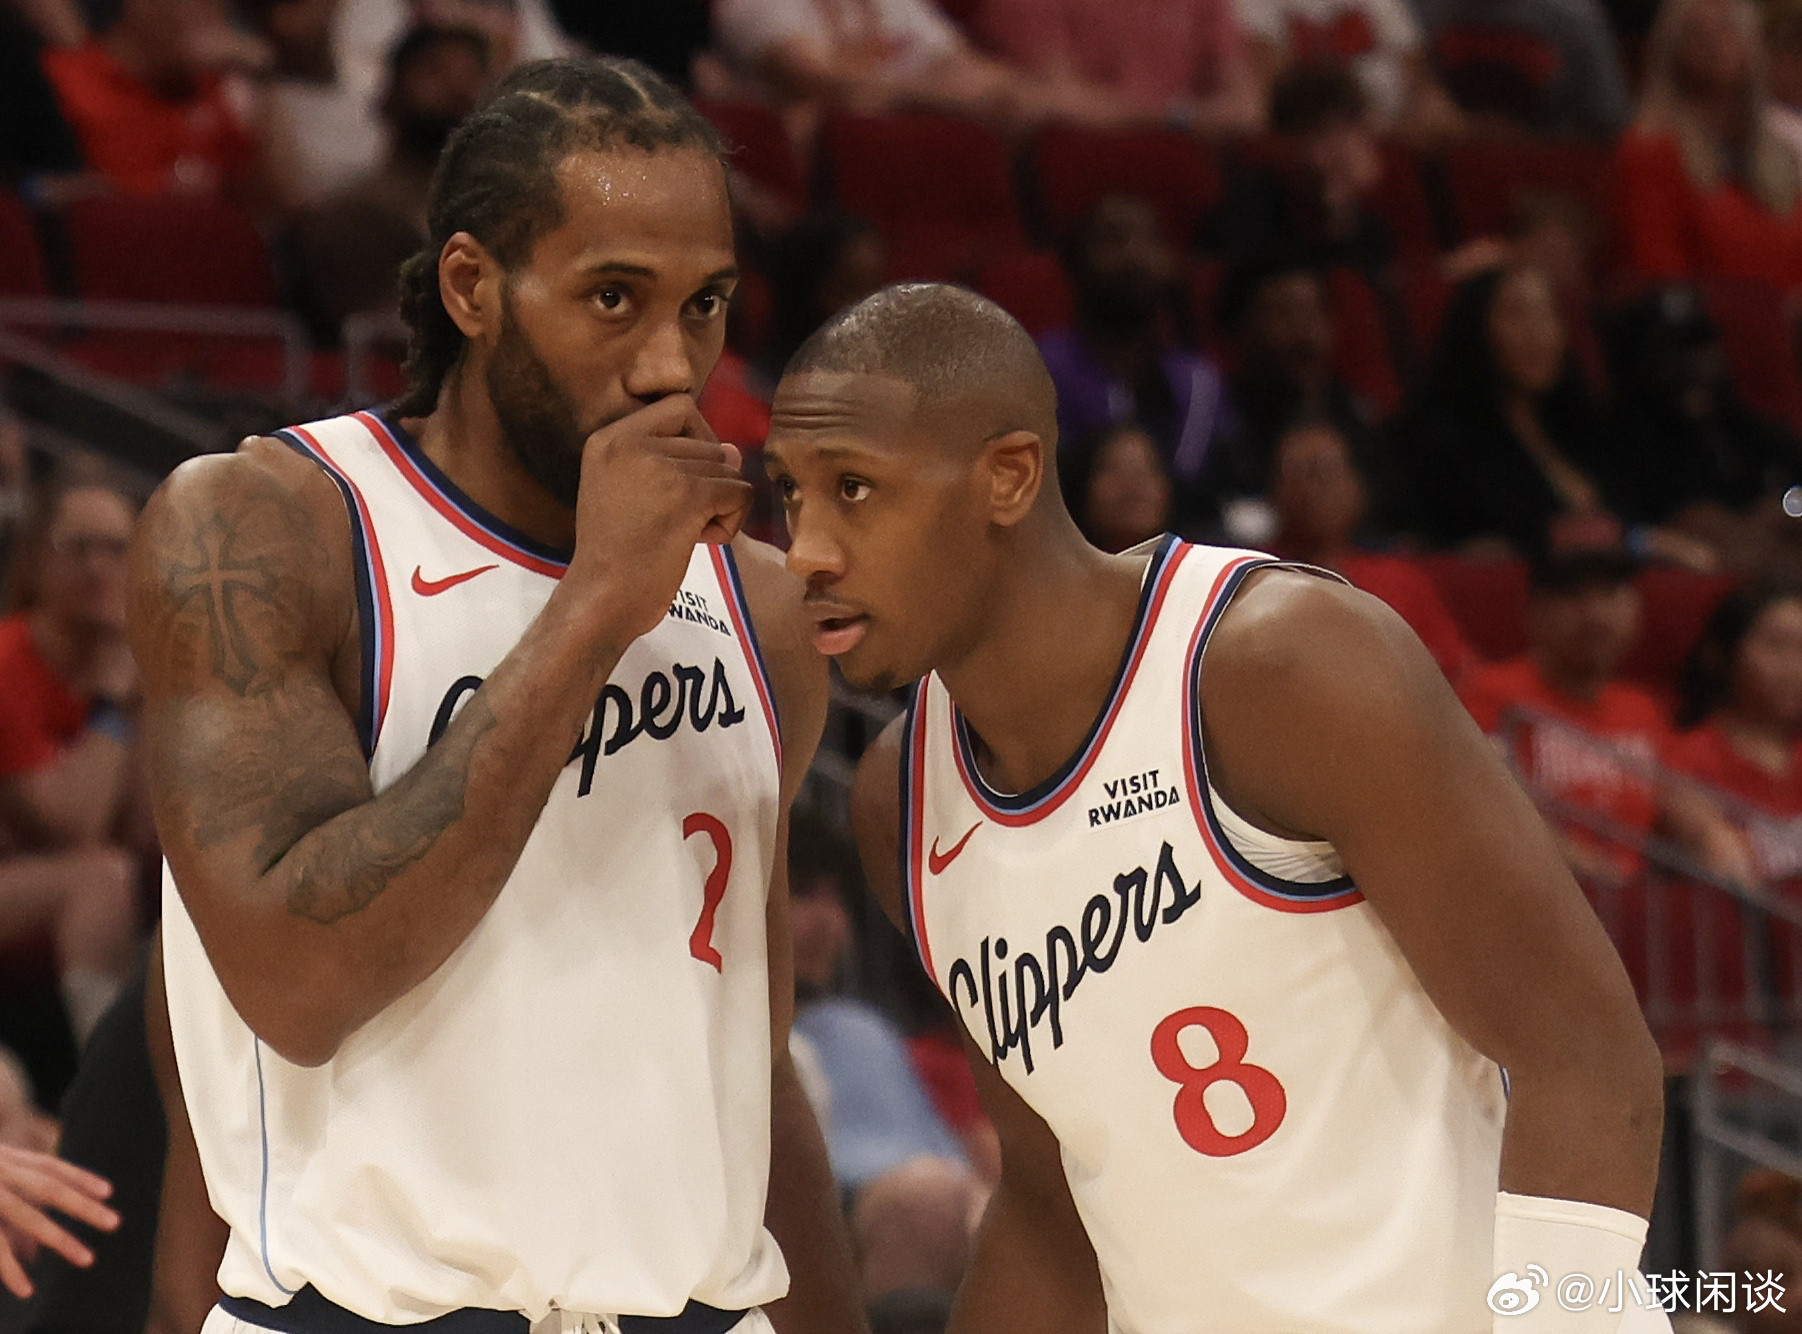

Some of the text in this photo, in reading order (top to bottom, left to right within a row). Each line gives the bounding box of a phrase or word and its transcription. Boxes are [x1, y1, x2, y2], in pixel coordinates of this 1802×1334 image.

[668, 603, 732, 637] WANDA
[676, 589, 709, 612] ISIT
[1103, 769, 1160, 799] VISIT
[1088, 785, 1180, 828] RWANDA
[682, 812, 733, 974] 2
[948, 840, 1202, 1076] Clippers
[1150, 1006, 1287, 1158] 8
